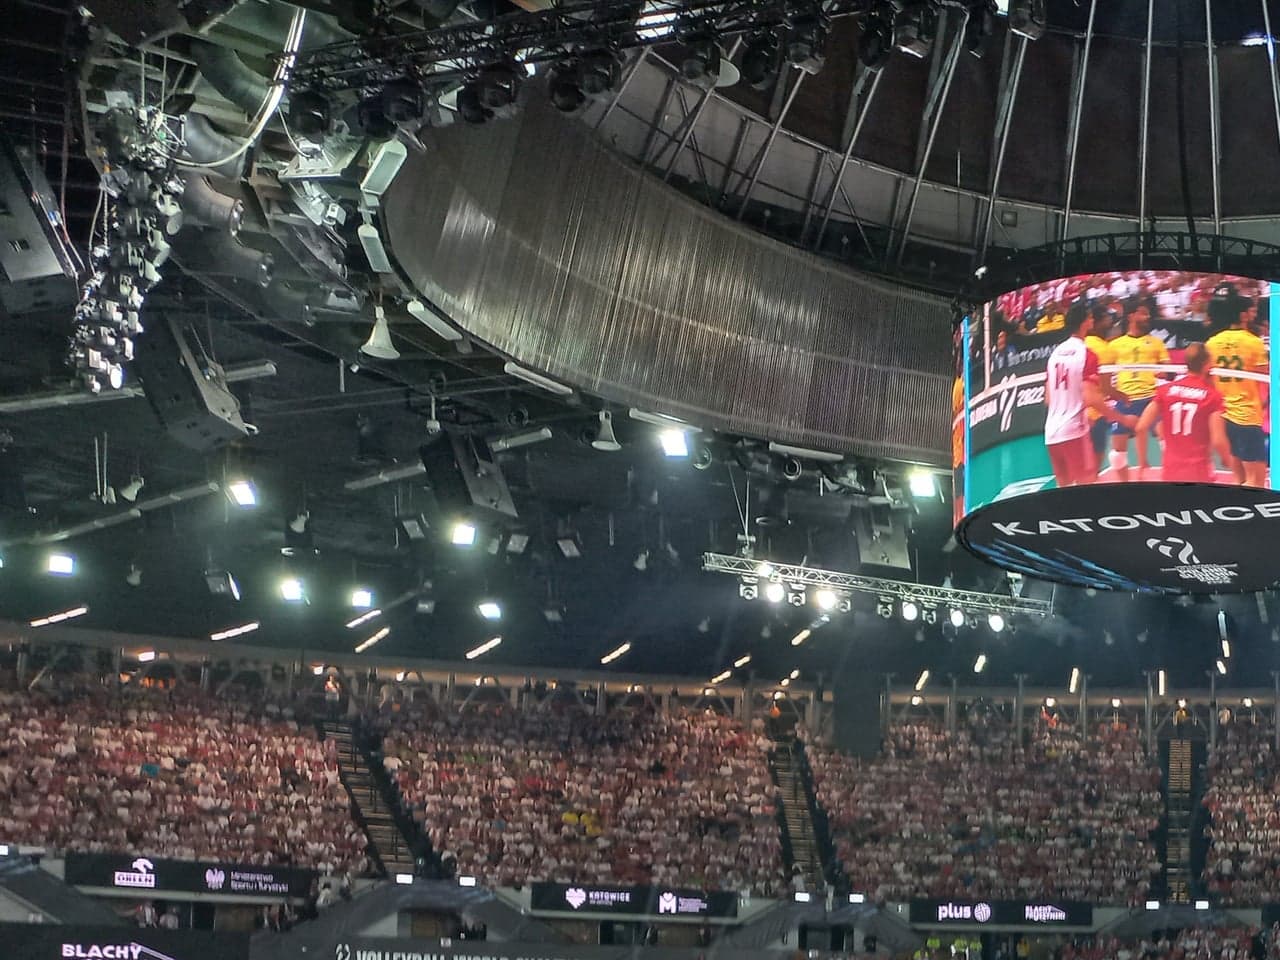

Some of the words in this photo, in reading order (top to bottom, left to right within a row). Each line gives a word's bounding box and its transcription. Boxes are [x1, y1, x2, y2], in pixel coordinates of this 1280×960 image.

[1168, 402, 1198, 435] 17
[937, 902, 972, 921] plus
[61, 943, 142, 960] BLACHY
